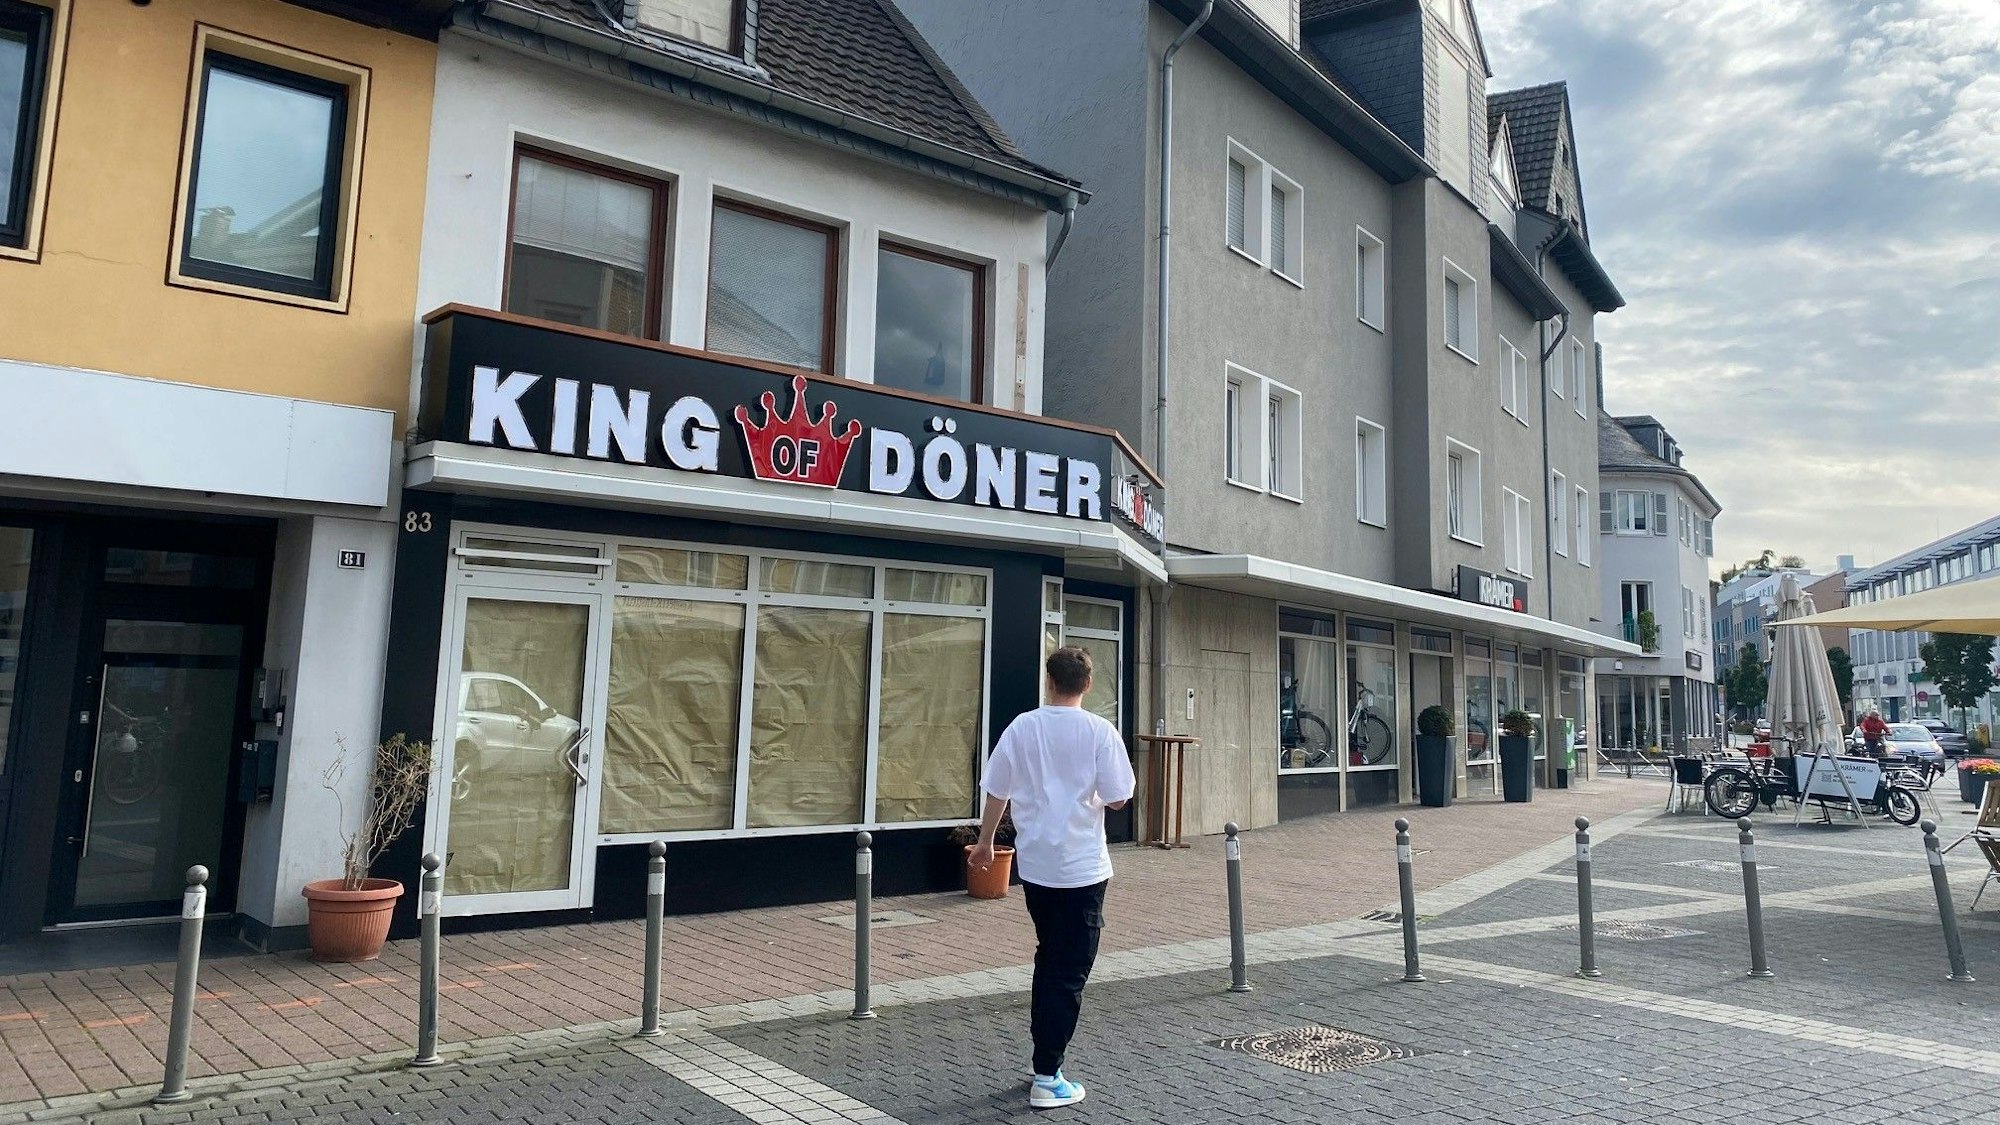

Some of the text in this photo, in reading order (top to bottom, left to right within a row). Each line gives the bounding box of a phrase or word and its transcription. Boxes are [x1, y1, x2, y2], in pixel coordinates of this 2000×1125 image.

[469, 365, 1102, 520] KING OF DÖNER
[404, 511, 432, 533] 83
[343, 552, 362, 566] 81
[1479, 573, 1515, 609] KRÄMER
